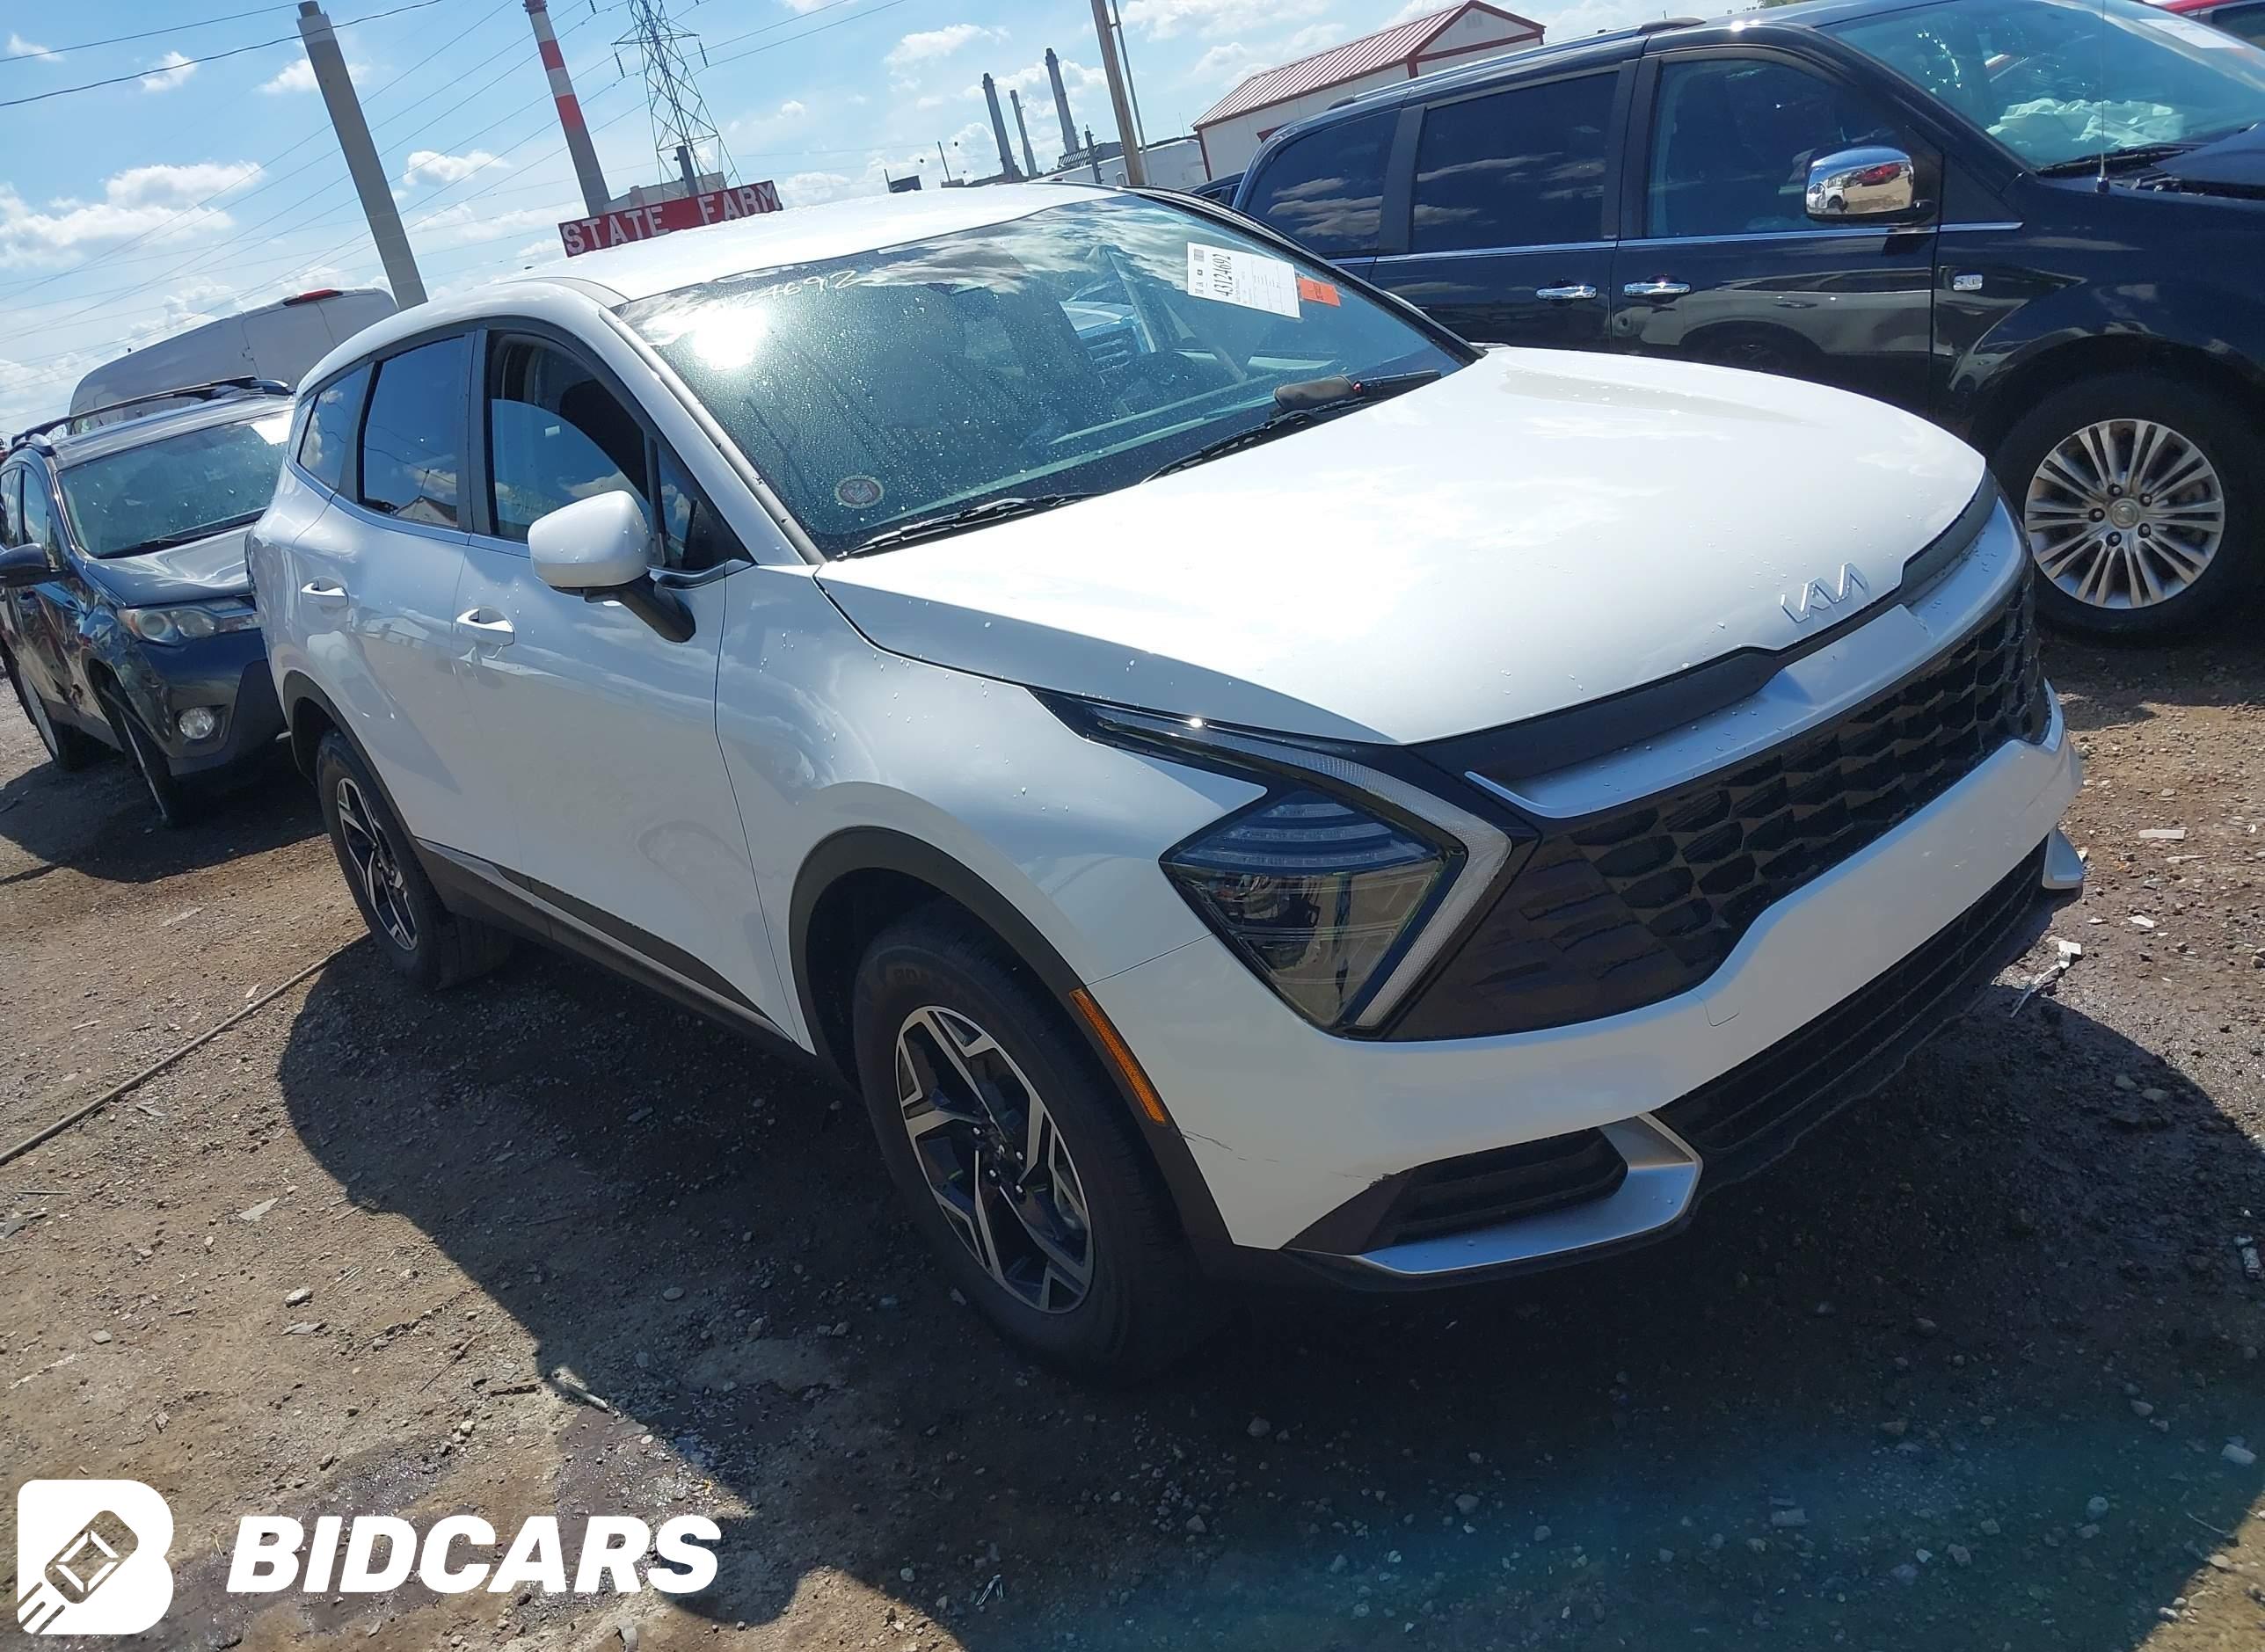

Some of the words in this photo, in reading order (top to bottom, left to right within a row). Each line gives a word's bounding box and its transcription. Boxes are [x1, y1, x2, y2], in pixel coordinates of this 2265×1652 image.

[562, 206, 669, 254] STATE
[697, 182, 782, 225] FARM
[1212, 253, 1233, 296] 43124692
